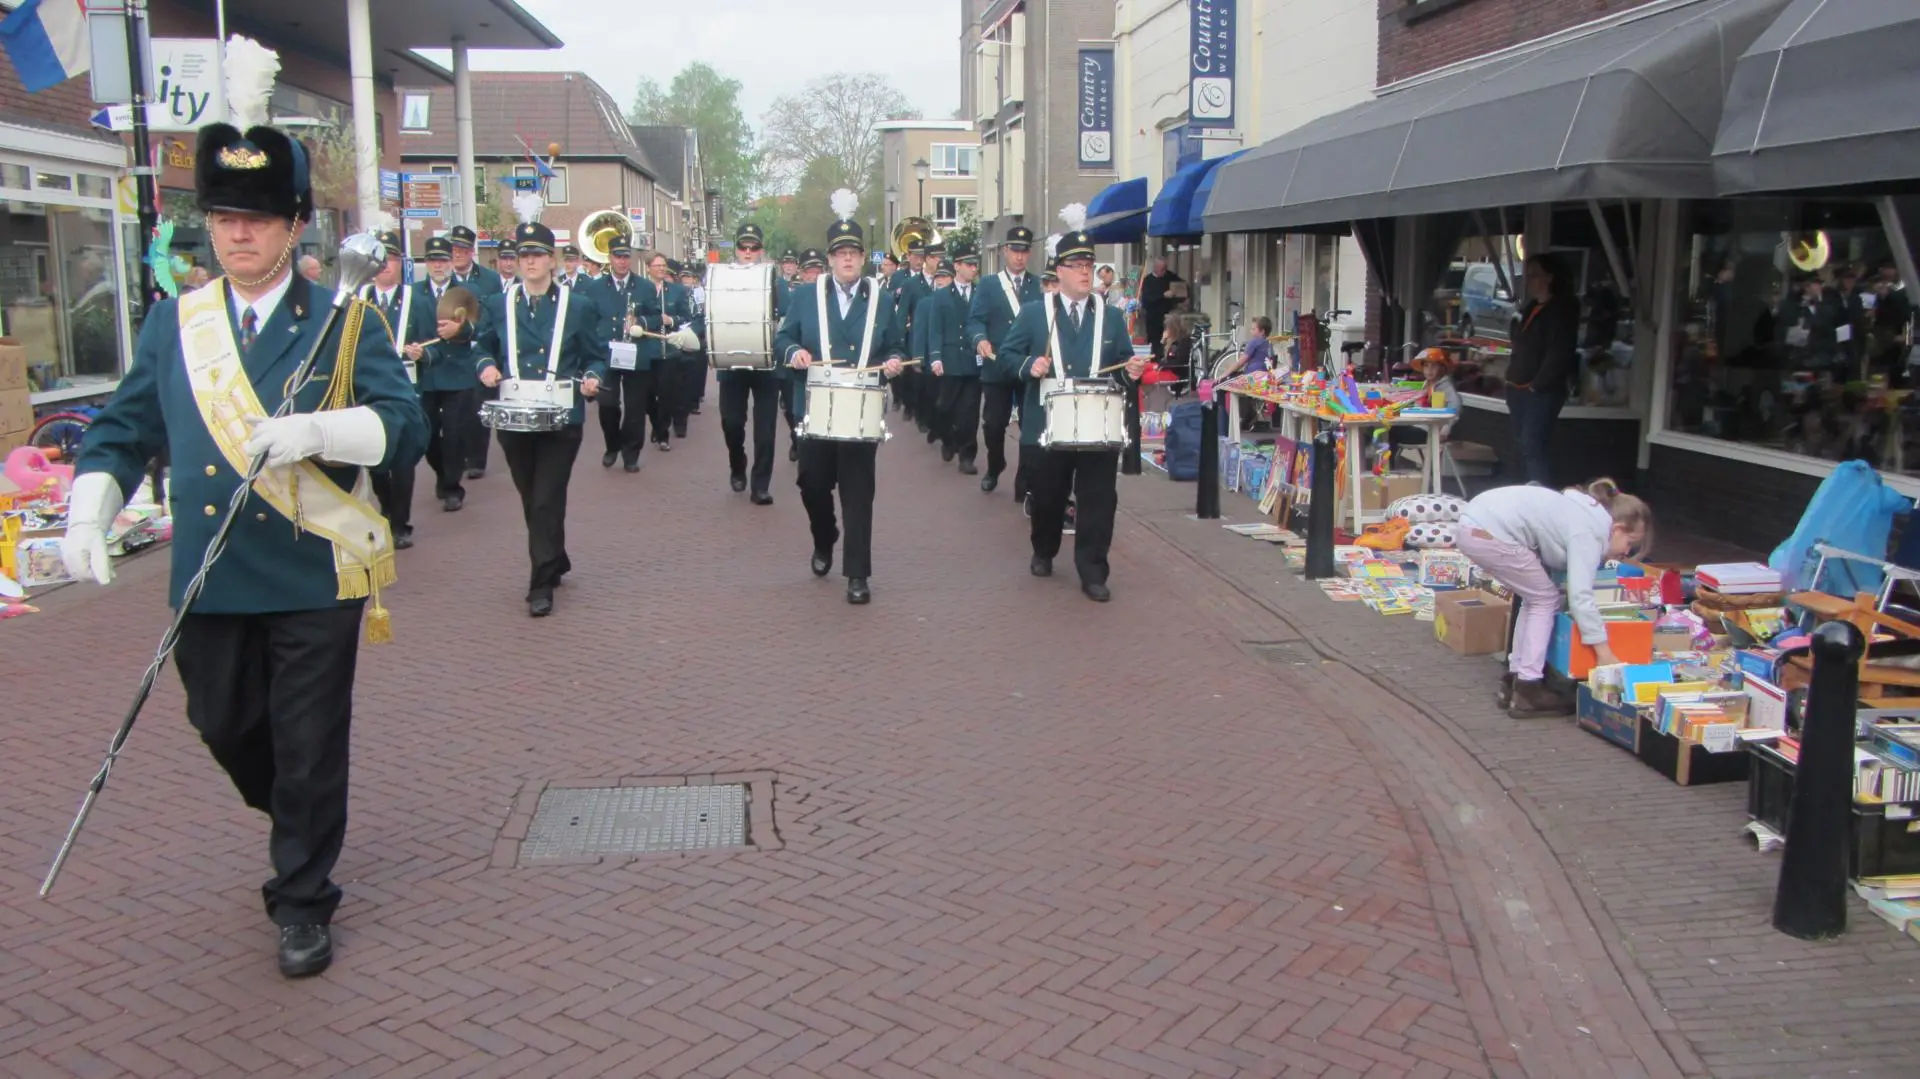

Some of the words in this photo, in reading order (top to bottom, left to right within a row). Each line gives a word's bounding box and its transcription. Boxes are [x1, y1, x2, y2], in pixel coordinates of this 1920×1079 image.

[1193, 0, 1211, 72] Count
[1217, 8, 1228, 73] wishes
[1081, 57, 1101, 128] Country
